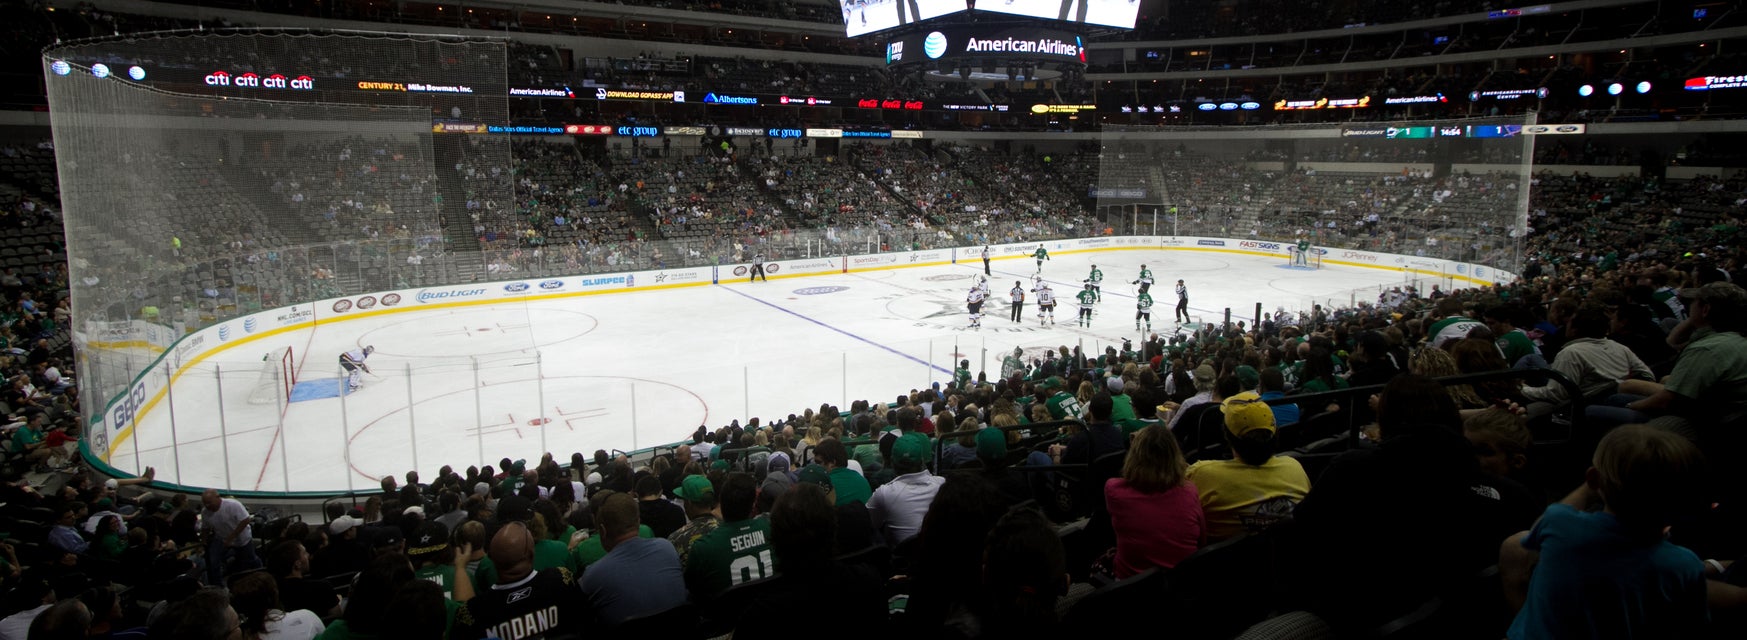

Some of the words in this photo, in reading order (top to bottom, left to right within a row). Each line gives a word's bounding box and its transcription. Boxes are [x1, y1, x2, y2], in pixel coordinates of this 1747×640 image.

[966, 37, 1035, 53] American
[1037, 39, 1077, 56] Airlines
[205, 74, 230, 86] citi
[235, 76, 258, 87] citi
[263, 77, 286, 88] citi
[291, 79, 313, 89] citi
[358, 82, 392, 90] CENTURY
[426, 84, 459, 92] Bowman,
[719, 96, 757, 104] Albertsons
[633, 127, 658, 136] group
[781, 129, 802, 138] group
[450, 288, 486, 297] LIGHT
[1084, 294, 1092, 304] 72
[114, 382, 145, 430] GECO
[730, 530, 765, 552] SEGUIN
[486, 605, 558, 640] MODANO
